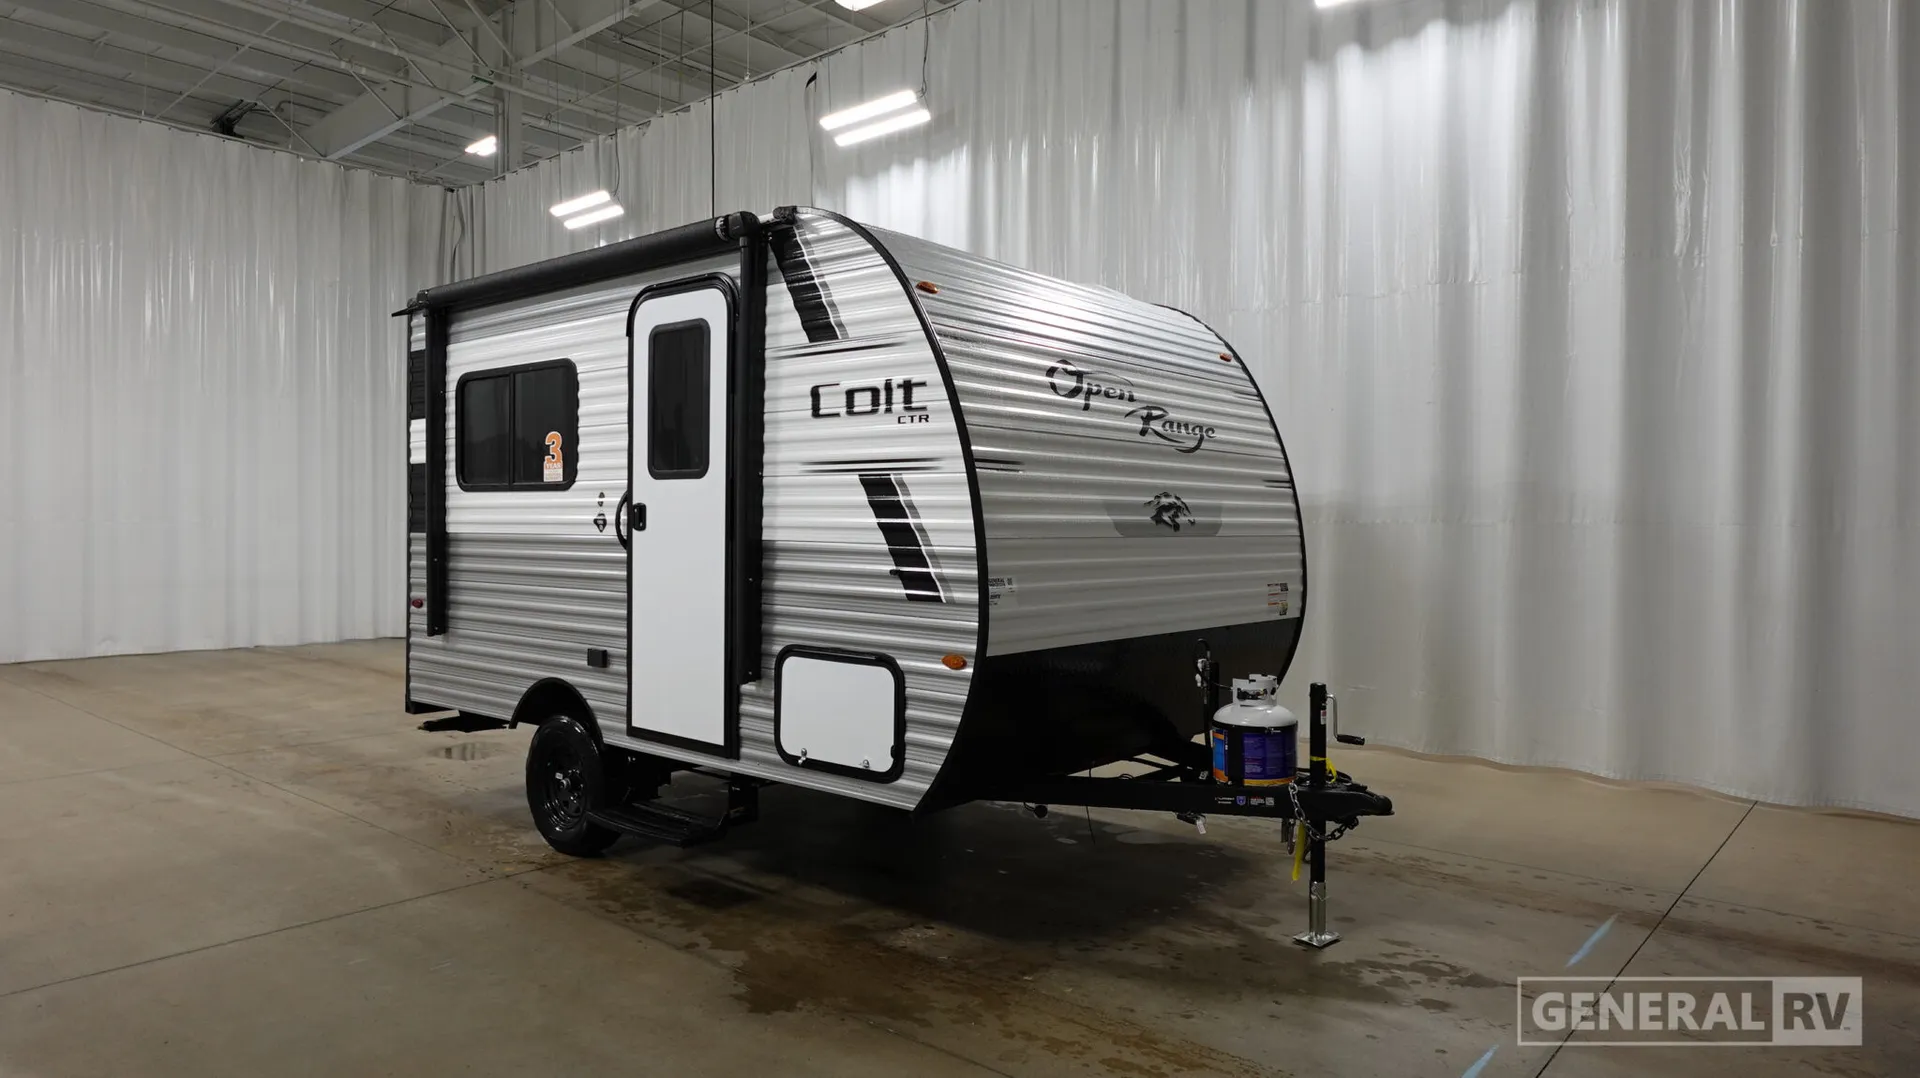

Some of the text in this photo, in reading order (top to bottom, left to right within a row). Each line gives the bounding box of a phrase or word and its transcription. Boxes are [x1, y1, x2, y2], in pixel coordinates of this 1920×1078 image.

[810, 379, 927, 418] Colt
[1045, 359, 1138, 411] Open
[897, 414, 929, 424] CTR
[1124, 405, 1217, 453] Range
[545, 431, 562, 463] 3
